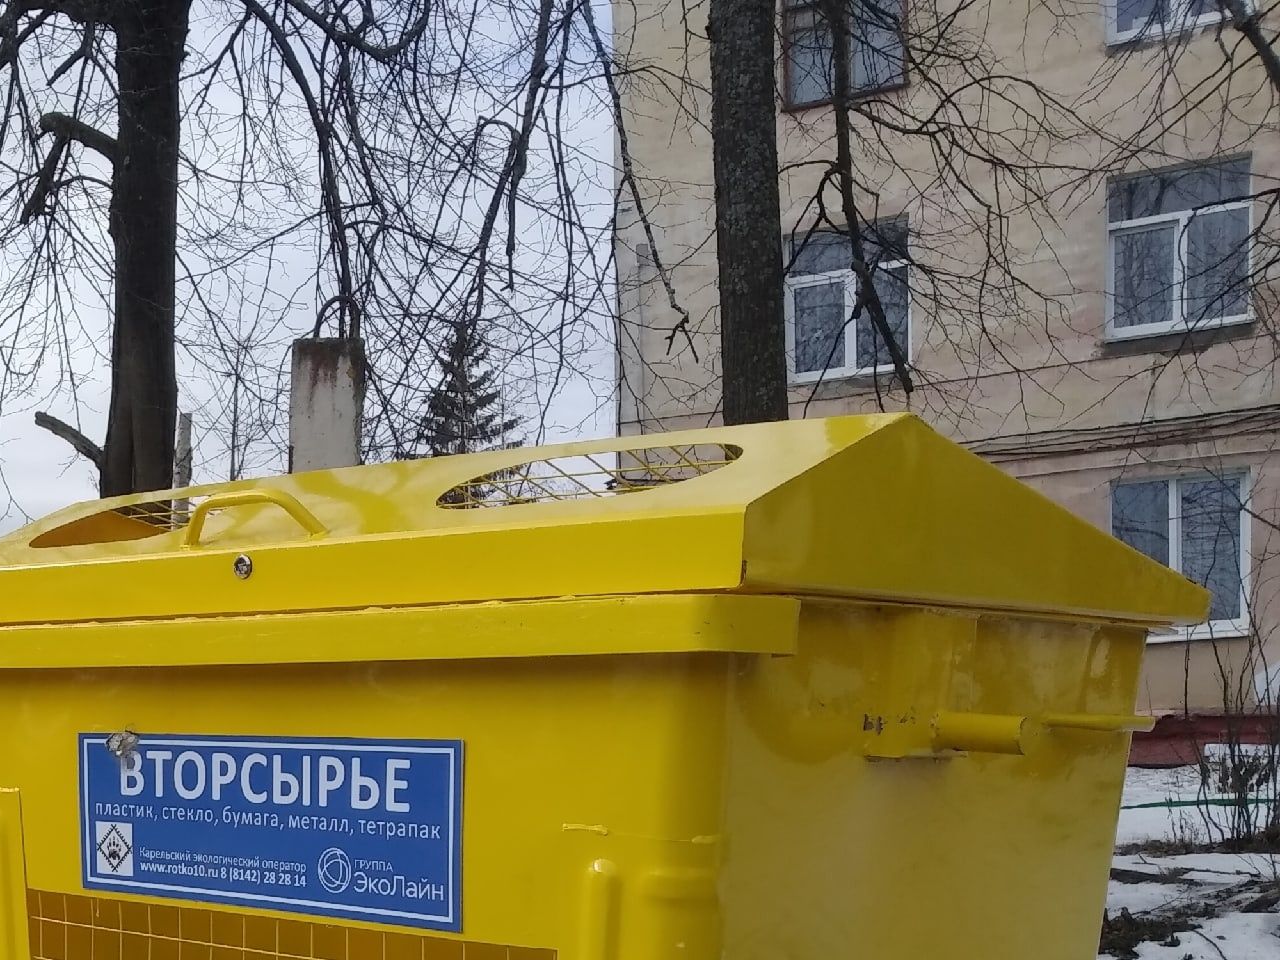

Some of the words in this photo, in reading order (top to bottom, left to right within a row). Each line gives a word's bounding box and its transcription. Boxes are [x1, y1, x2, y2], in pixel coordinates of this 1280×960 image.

[120, 750, 411, 812] ВТОРСЫРЬЕ
[95, 802, 158, 821] пластик,
[162, 806, 219, 826] стекло,
[222, 806, 285, 830] бумага,
[288, 814, 354, 836] металл,
[358, 818, 441, 840] тетрапак
[139, 847, 191, 862] Карельский
[192, 853, 260, 868] экологический
[261, 859, 307, 873] оператор
[140, 861, 219, 878] www.rotko10.ru
[220, 867, 227, 879] 8
[229, 868, 261, 885] (8142)
[263, 871, 276, 884] 28
[278, 873, 292, 886] 28
[293, 875, 307, 887] 14
[354, 859, 394, 872] ГРУППА
[353, 871, 444, 901] ЭкоЛайн
